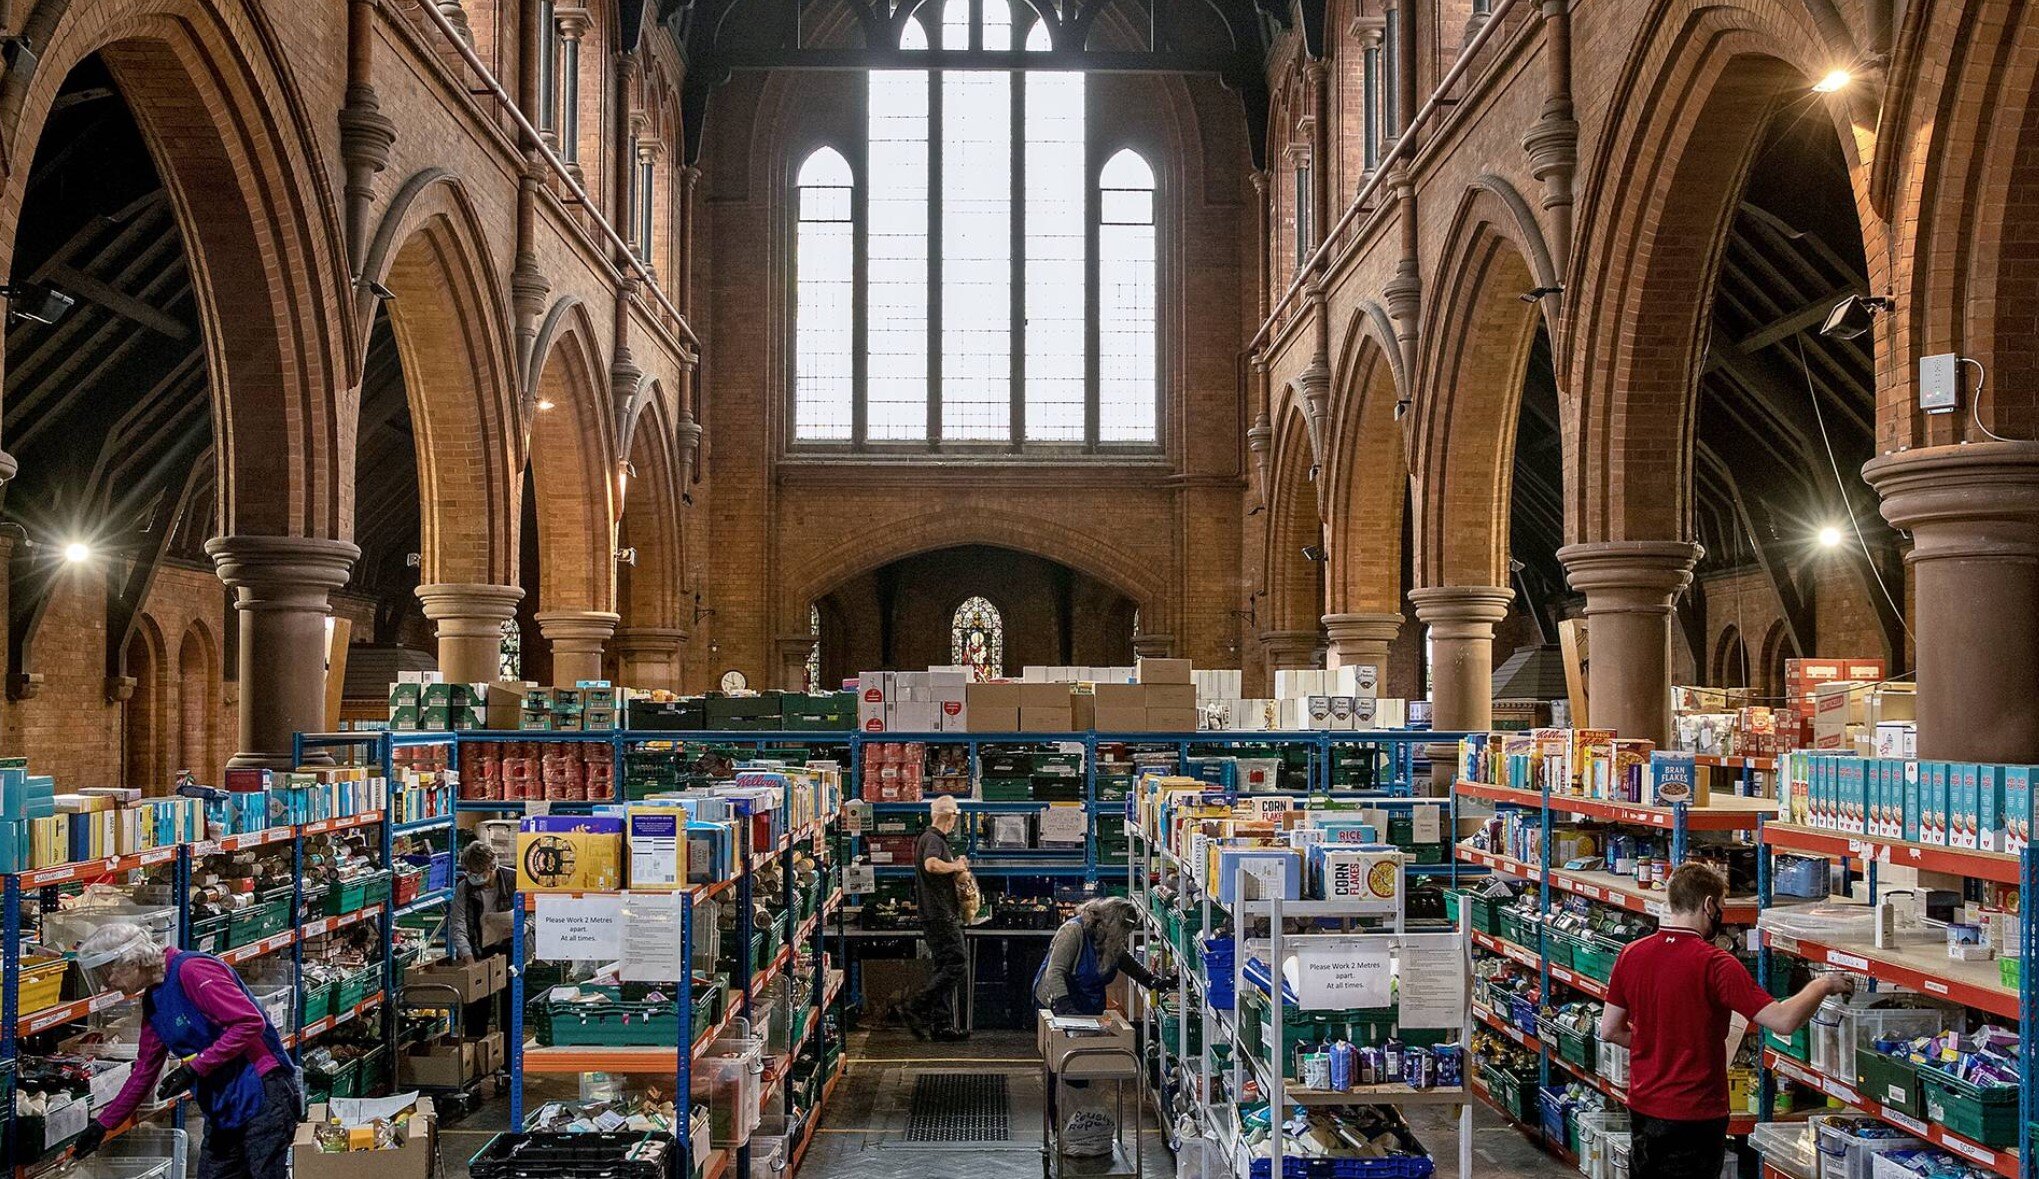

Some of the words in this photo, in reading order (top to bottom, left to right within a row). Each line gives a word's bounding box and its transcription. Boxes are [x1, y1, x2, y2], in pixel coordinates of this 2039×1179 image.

[1664, 766, 1685, 774] BRAN
[1661, 773, 1688, 782] FLAKES
[1262, 800, 1286, 812] CORN
[1262, 812, 1283, 822] FLAKE
[1339, 830, 1362, 840] RICE
[1335, 863, 1349, 896] CORN
[1349, 863, 1360, 896] FLAKES
[545, 916, 566, 924] Please
[566, 916, 583, 924] Work
[584, 916, 589, 924] 2
[590, 916, 613, 924] Metres
[1309, 963, 1331, 971] Please
[1331, 962, 1350, 970] Work
[1357, 961, 1381, 969] Metres
[1960, 1143, 1976, 1154] SOAP
